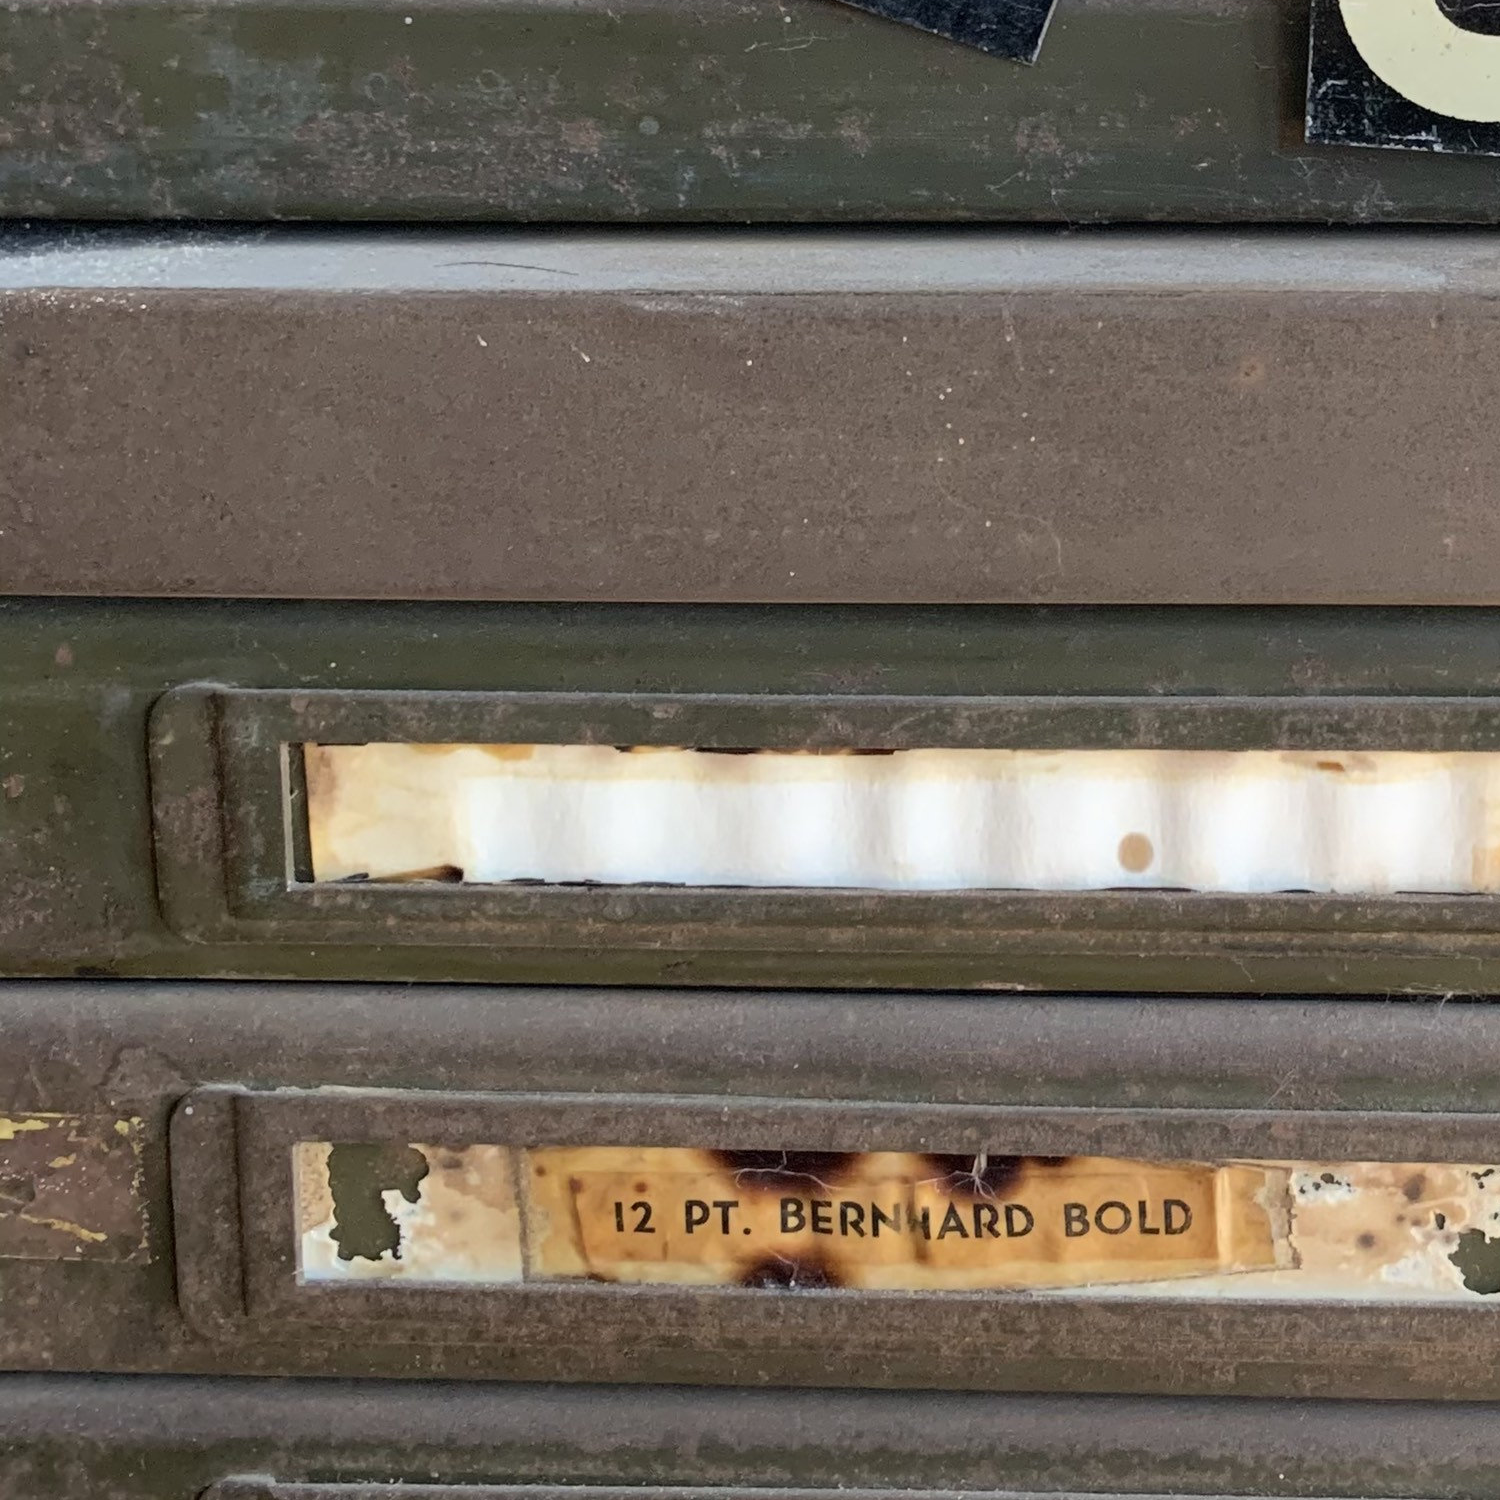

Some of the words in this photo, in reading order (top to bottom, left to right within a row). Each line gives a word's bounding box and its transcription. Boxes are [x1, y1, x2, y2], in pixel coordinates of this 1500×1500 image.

[614, 1200, 656, 1235] 12
[684, 1200, 752, 1236] PT.
[779, 1199, 1035, 1240] BERNHARD
[1064, 1199, 1193, 1237] BOLD
